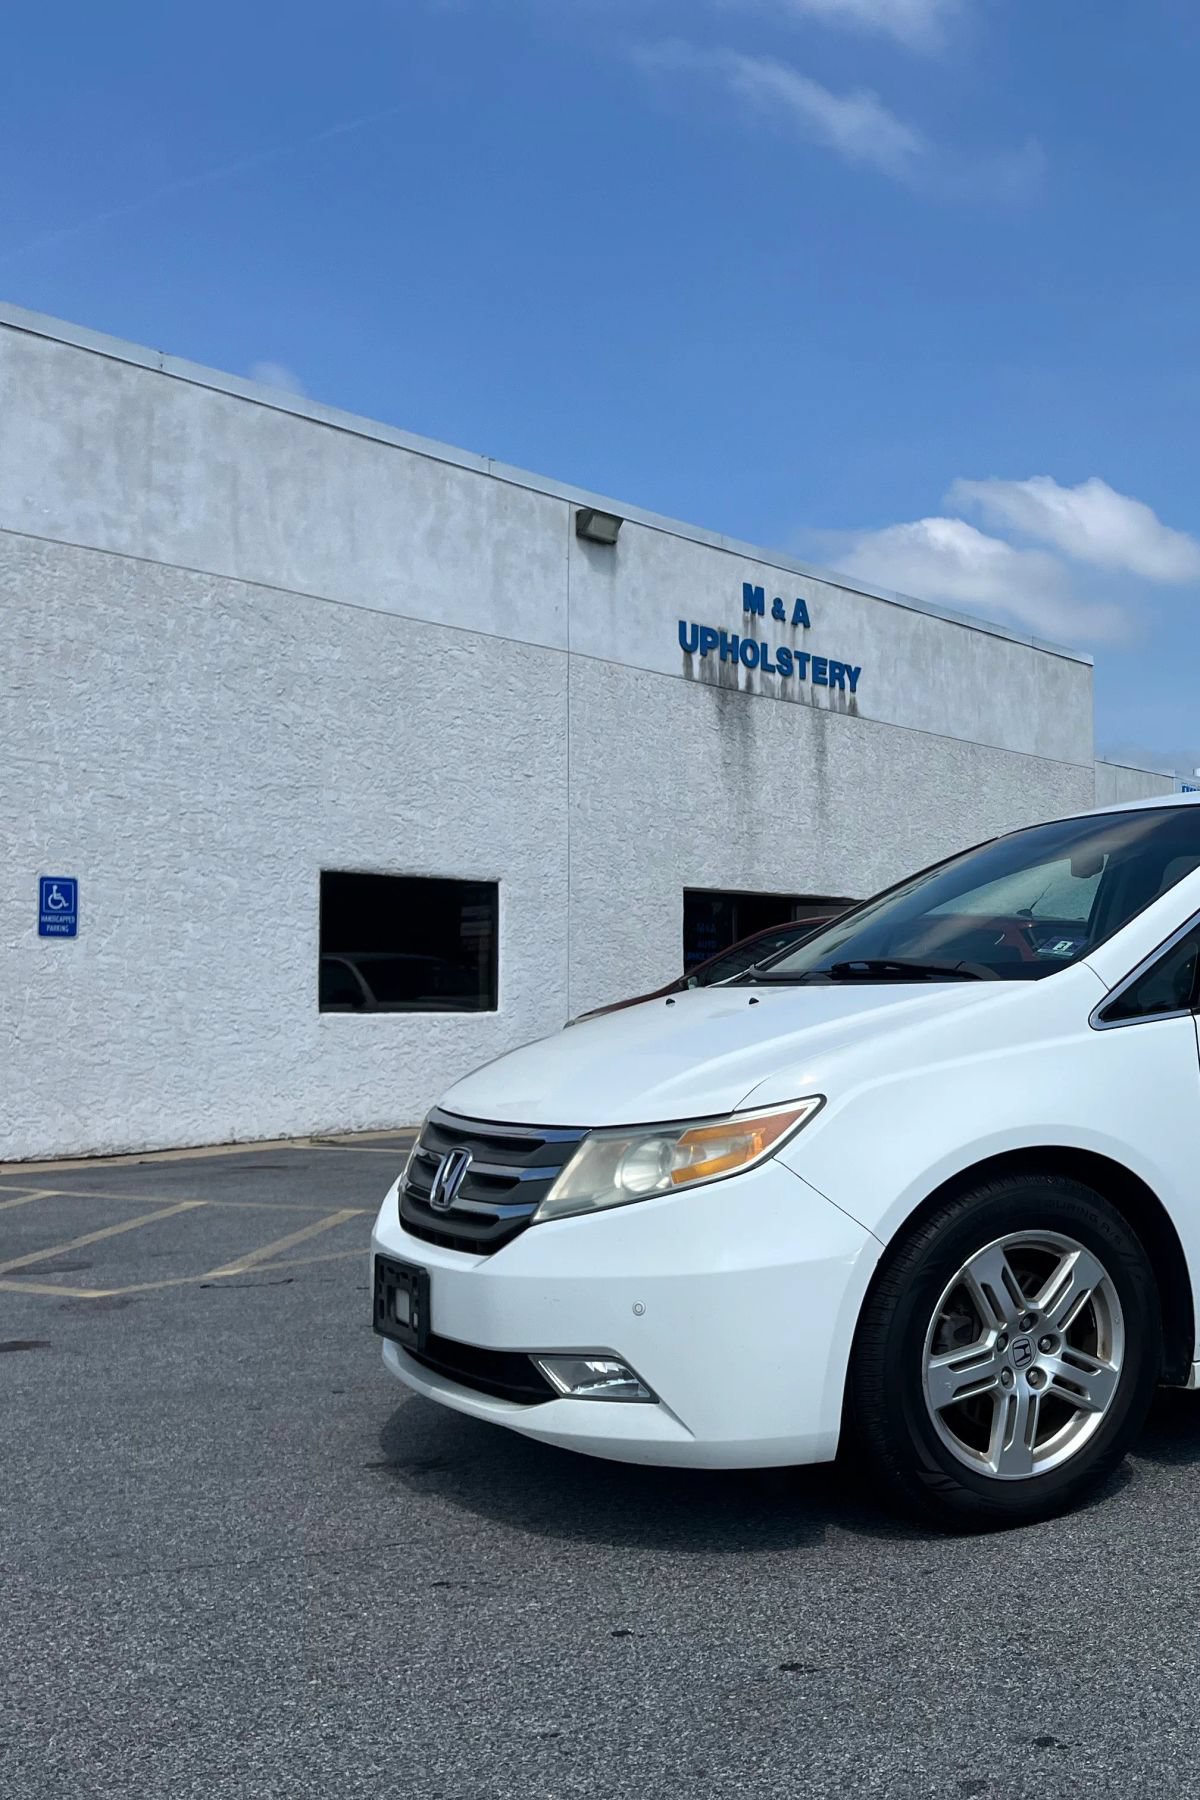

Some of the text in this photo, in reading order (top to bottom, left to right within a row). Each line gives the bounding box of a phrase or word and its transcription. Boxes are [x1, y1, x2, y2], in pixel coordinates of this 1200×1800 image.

[743, 582, 811, 628] M & A
[678, 620, 862, 693] UPHOLSTERY
[46, 924, 70, 933] PARKING
